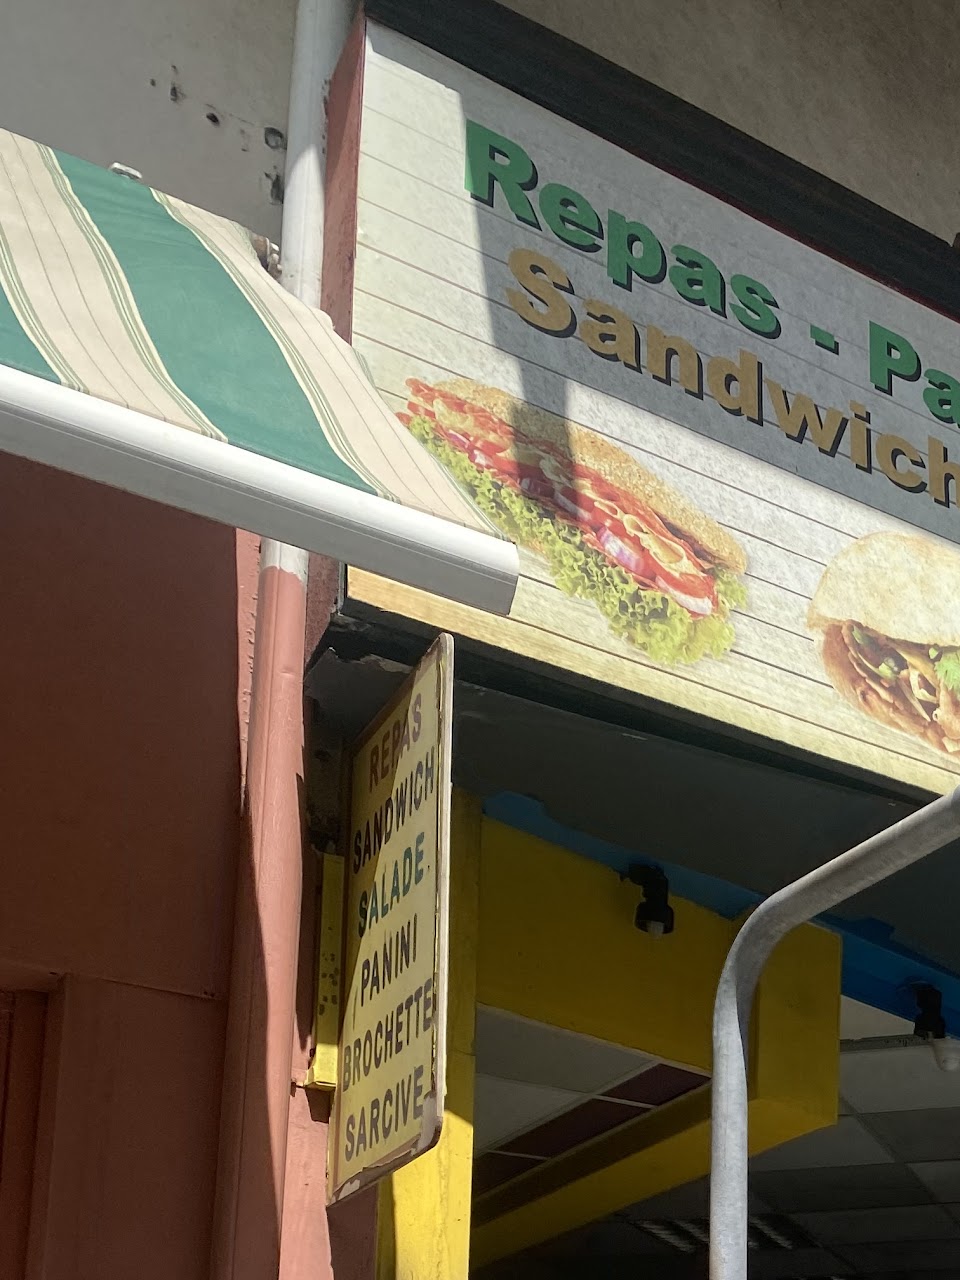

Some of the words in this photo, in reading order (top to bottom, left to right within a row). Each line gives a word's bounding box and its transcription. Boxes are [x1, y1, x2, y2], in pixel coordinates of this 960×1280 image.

[464, 119, 782, 340] Repas
[369, 692, 422, 793] REPAS
[353, 745, 435, 875] SANDWICH
[359, 831, 425, 937] SALADE
[361, 912, 418, 1007] PANINI
[342, 977, 433, 1093] BROCHETTE
[345, 1063, 424, 1162] SARCIVE
